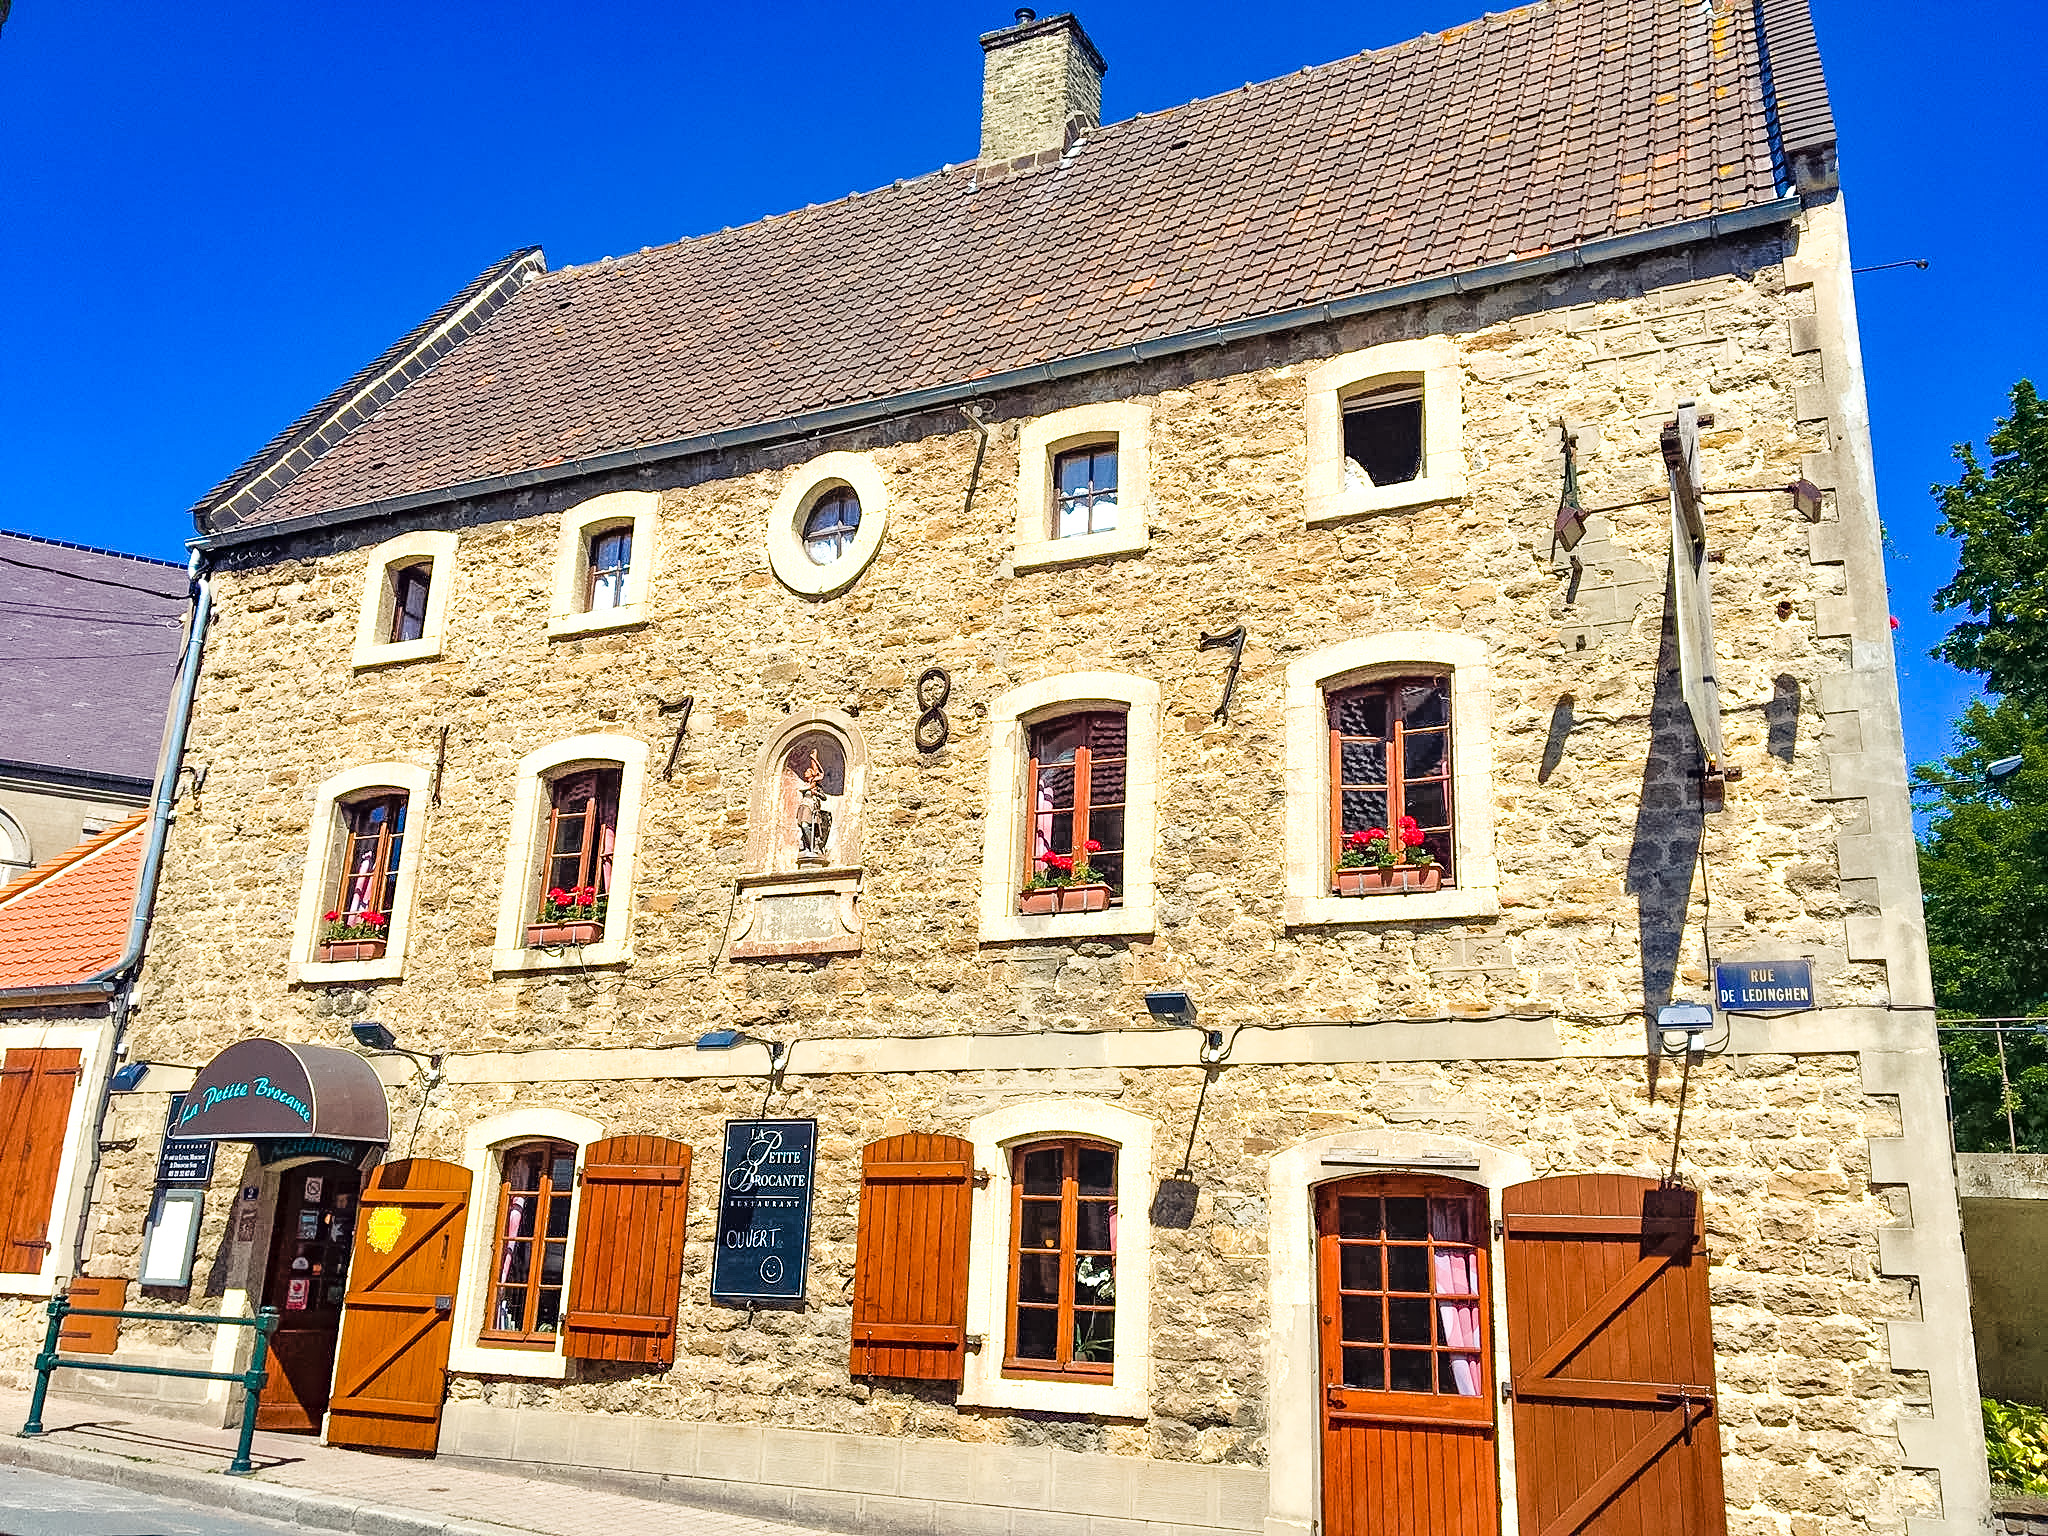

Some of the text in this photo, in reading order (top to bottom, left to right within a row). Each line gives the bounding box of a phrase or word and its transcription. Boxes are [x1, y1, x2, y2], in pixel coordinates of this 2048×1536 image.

[915, 666, 950, 754] 8
[1749, 969, 1775, 983] RUE
[1721, 987, 1809, 1003] DE LEDINGHEN
[179, 1076, 311, 1129] La Petite Brocante
[750, 1128, 765, 1140] LA
[747, 1130, 801, 1167] PETITE
[727, 1159, 806, 1193] BROCANTE
[730, 1200, 800, 1208] RESTAURANT
[726, 1228, 782, 1249] OUVERT
